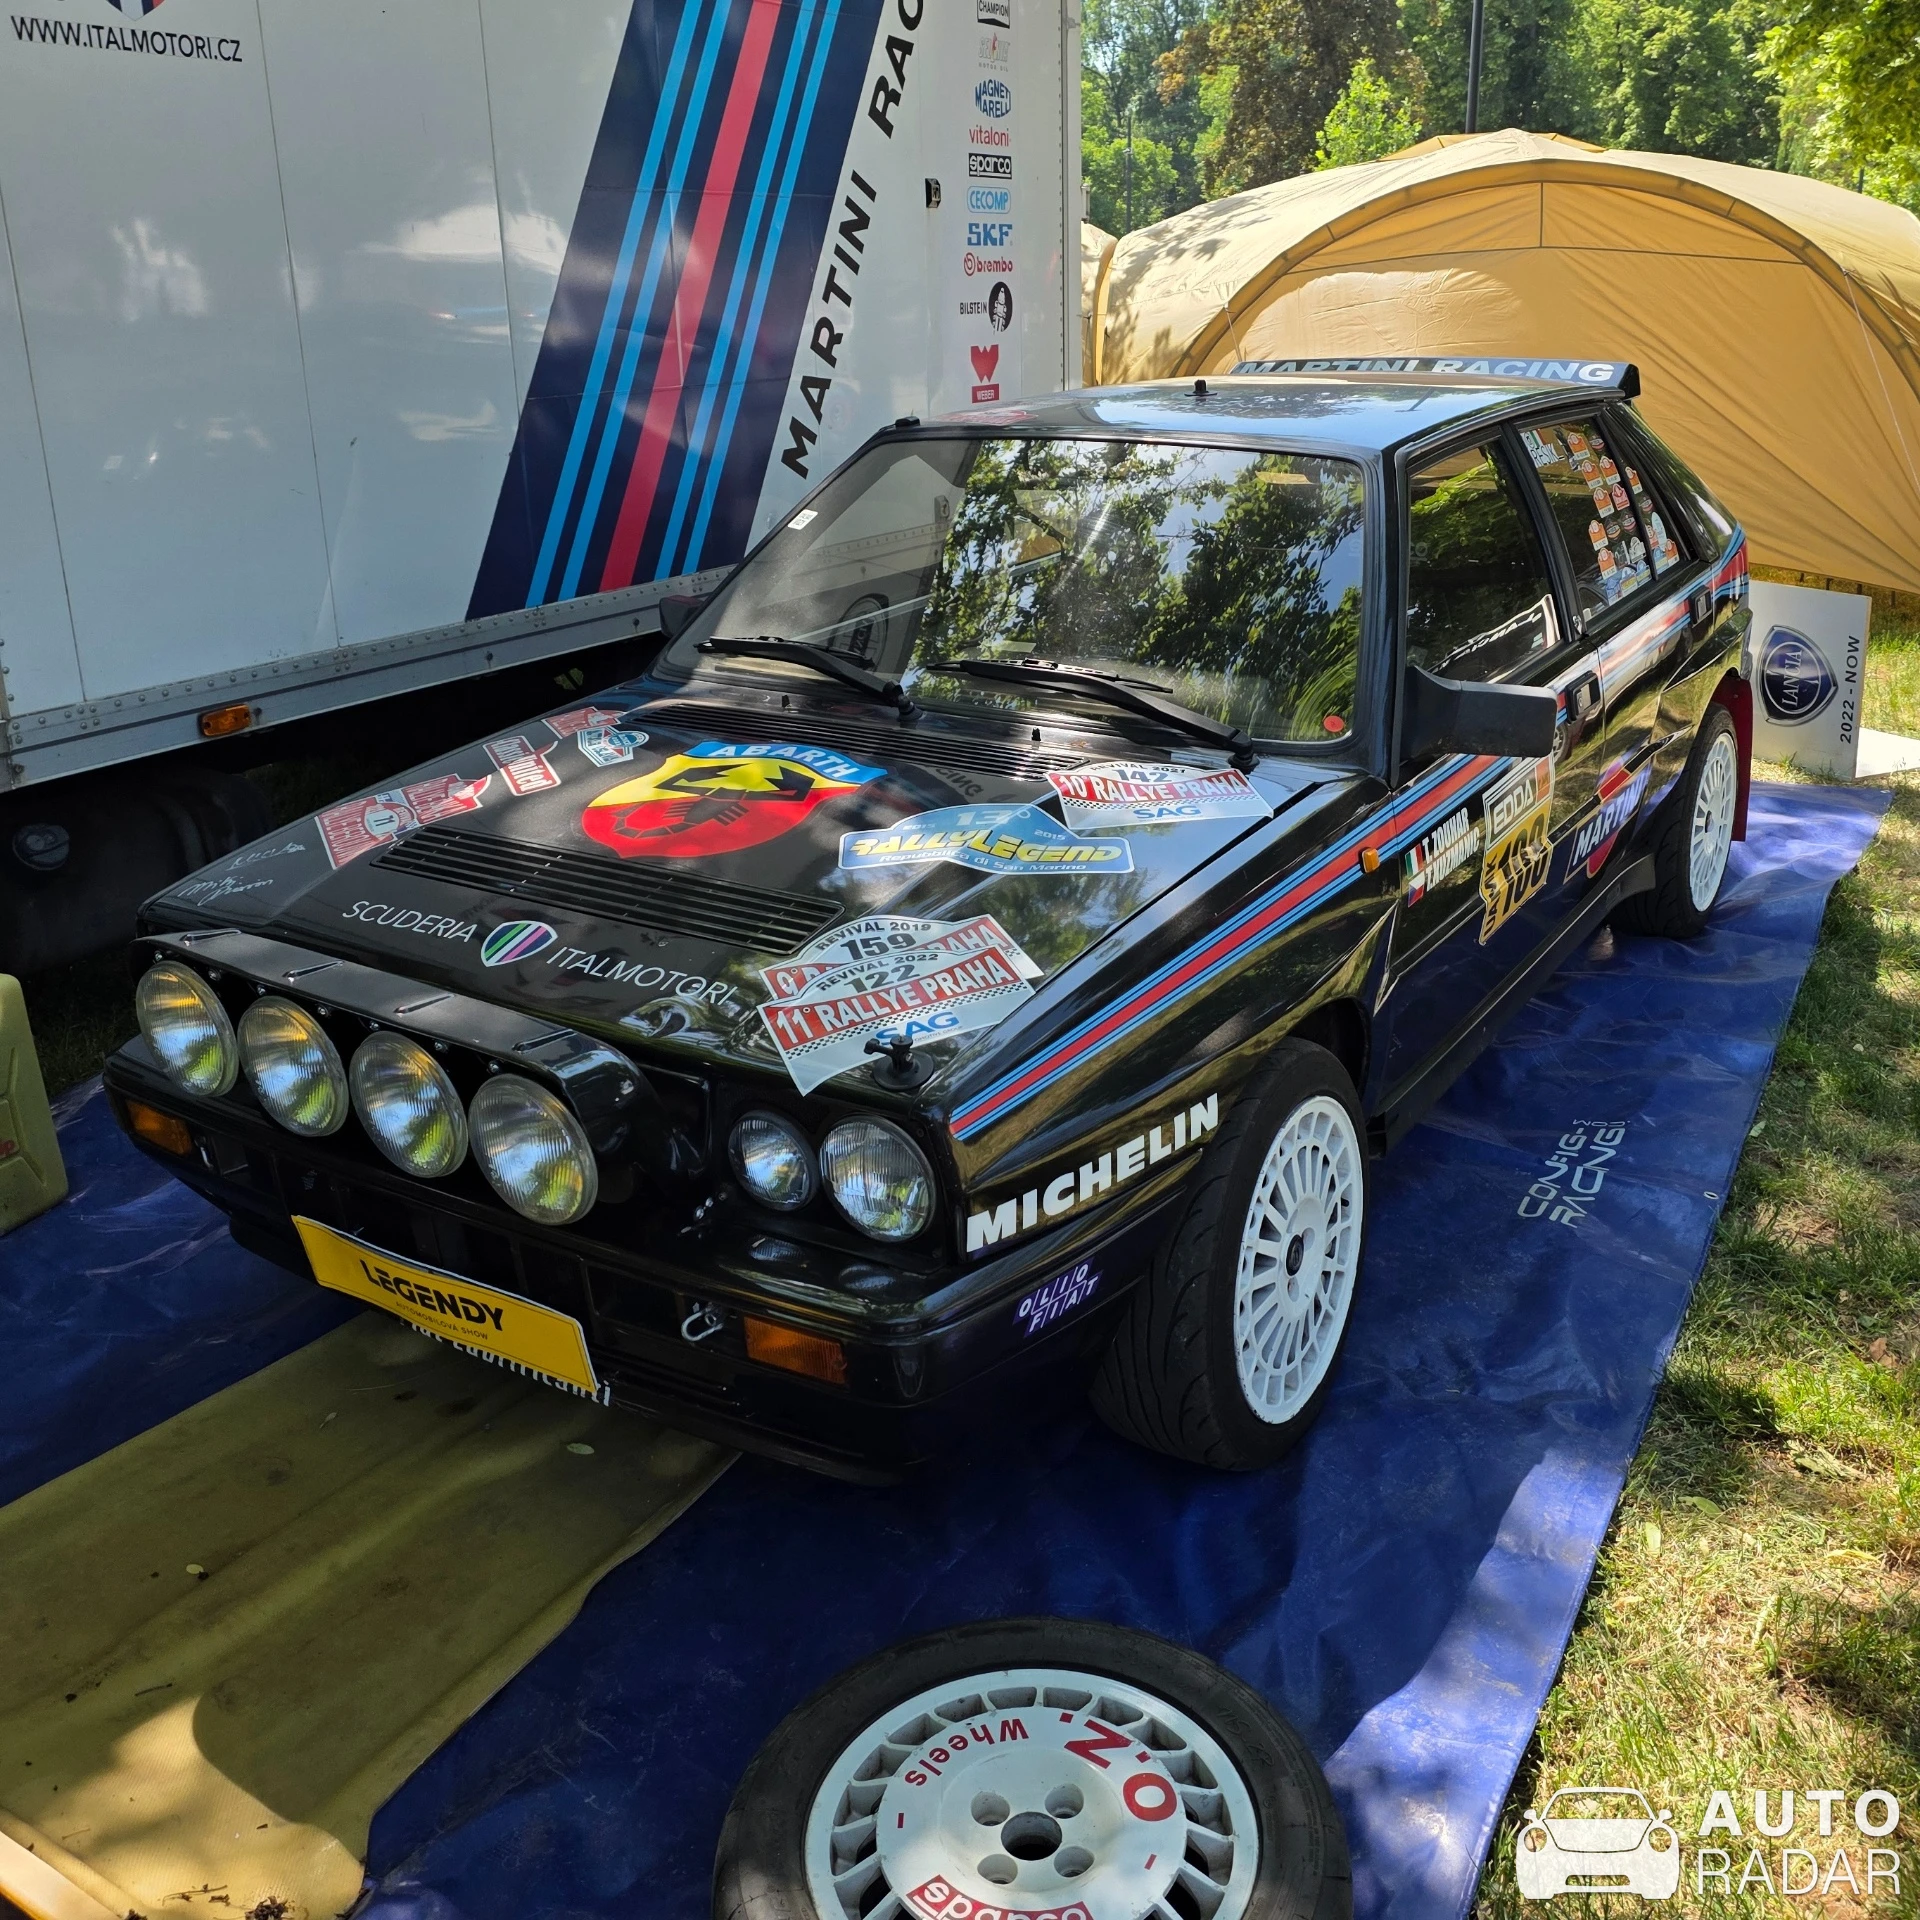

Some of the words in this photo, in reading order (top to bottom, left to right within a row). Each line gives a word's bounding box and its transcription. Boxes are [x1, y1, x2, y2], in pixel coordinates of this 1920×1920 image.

[978, 0, 1009, 17] CHAMPION
[10, 15, 243, 62] WWW.ITALMOTORI.CZ
[969, 125, 1009, 147] vitaloni
[969, 155, 1011, 176] sparco
[970, 190, 1009, 210] CECOMP
[967, 223, 1013, 246] SKF
[976, 256, 1013, 273] brembo
[959, 302, 988, 315] BILSTEIN
[781, 169, 877, 480] MARTINI
[1239, 360, 1419, 374] MARTINI
[1431, 360, 1615, 382] RACING
[977, 390, 995, 401] WEBER
[1845, 635, 1860, 684] NOW
[1781, 650, 1802, 707] LANCIA
[1840, 699, 1855, 744] 2022
[710, 744, 860, 778] ABARTH
[1090, 760, 1149, 771] REVIVAL
[1152, 765, 1186, 774] 2021
[1112, 769, 1172, 783] 142
[1092, 776, 1175, 803] RALLYE
[1174, 773, 1250, 799] PRAHA
[1133, 804, 1202, 819] SAG
[1494, 779, 1534, 835] EDDA
[1033, 829, 1067, 841] 2015
[878, 848, 970, 863] Repubblica
[974, 855, 989, 867] di
[992, 861, 1024, 872] San
[816, 921, 886, 952] REVIVAL
[889, 921, 932, 933] 2019
[840, 932, 917, 960] 159
[342, 900, 478, 943] SCUDERIA
[546, 946, 739, 1006] ITALMOTORI
[816, 960, 890, 992] REVIVAL
[894, 953, 939, 965] 2022
[843, 964, 921, 994] 122
[813, 984, 921, 1032] RALLYE
[921, 955, 1014, 1000] PRAHA
[875, 1011, 960, 1046] SAG
[967, 1092, 1219, 1254] MICHELIN
[1548, 1127, 1626, 1229] RACING
[359, 1259, 504, 1332] LEGENDY
[1018, 1263, 1089, 1318] OLIO
[1028, 1275, 1099, 1333] FIAT
[460, 1327, 489, 1341] SHOW
[904, 1718, 1030, 1787] Wheels
